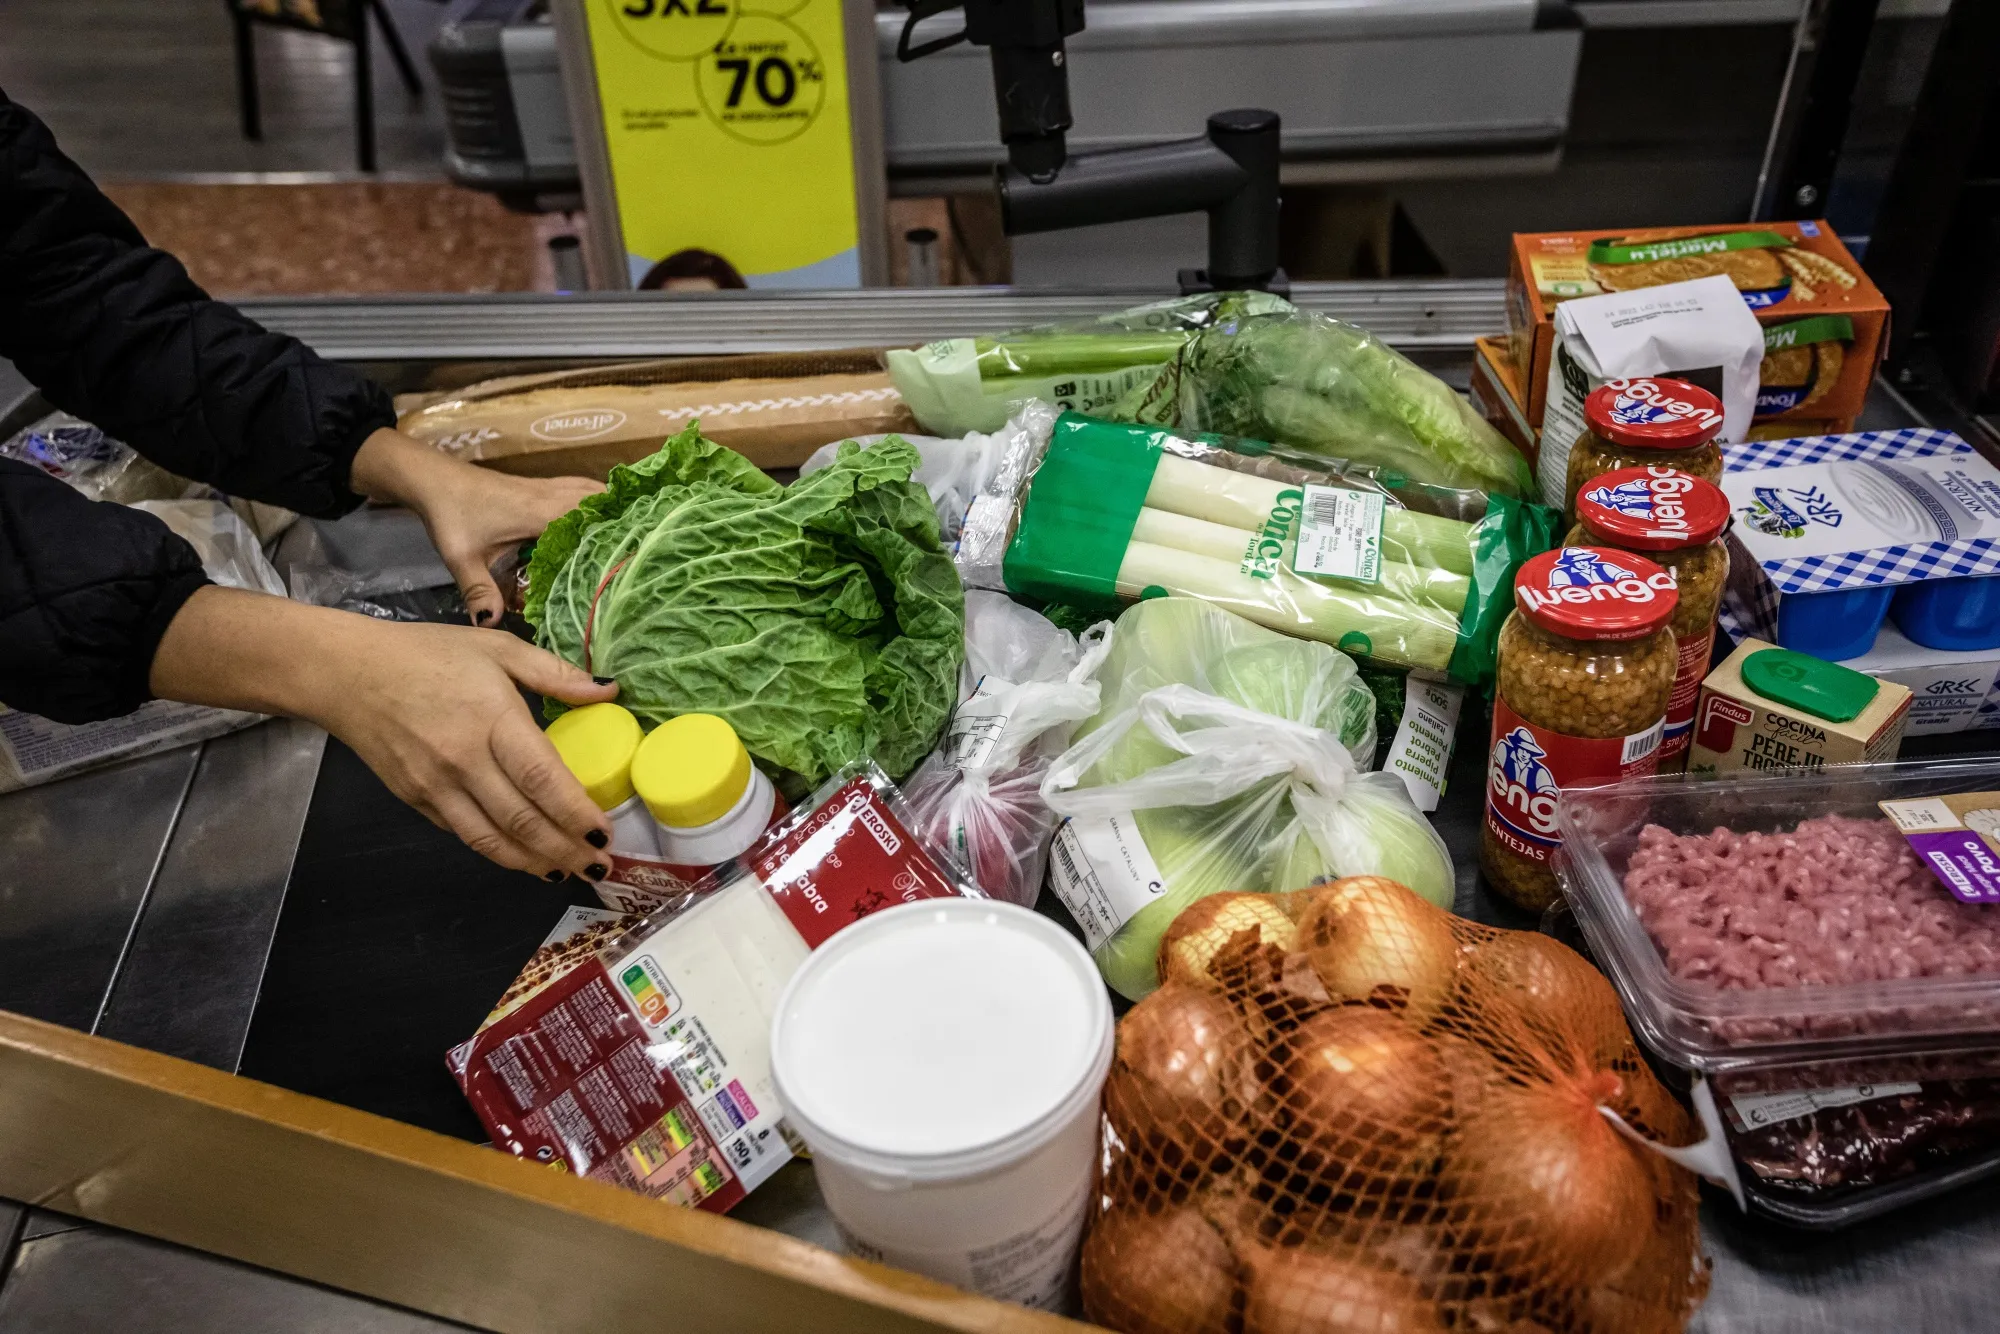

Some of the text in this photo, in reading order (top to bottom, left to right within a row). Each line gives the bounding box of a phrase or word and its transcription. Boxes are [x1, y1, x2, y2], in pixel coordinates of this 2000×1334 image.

[1629, 239, 1727, 261] MarieLu
[1748, 293, 1772, 307] FO
[1764, 329, 1797, 346] Ma
[1787, 486, 1843, 528] GREC
[1939, 478, 1987, 512] NATURAL
[1925, 678, 1981, 694] GREC
[1713, 701, 1747, 722] Findus
[1916, 698, 1967, 708] NATURAL
[1408, 720, 1448, 753] Pemento
[1418, 711, 1446, 736] Italiano
[1766, 712, 1827, 743] COCINA
[1405, 747, 1439, 775] Piperra
[1410, 735, 1441, 762] Pebrot
[1395, 758, 1440, 790] Pimiento
[1488, 760, 1561, 834] eng
[861, 808, 899, 852] EROSKI
[1487, 814, 1546, 861] LENTEJAS
[1109, 817, 1140, 882] GRANNY CATALUNY
[1931, 853, 1966, 884] EROSKI
[797, 875, 829, 914] abra
[642, 959, 672, 998] NUTRI-SCORE
[730, 1136, 751, 1159] 150
